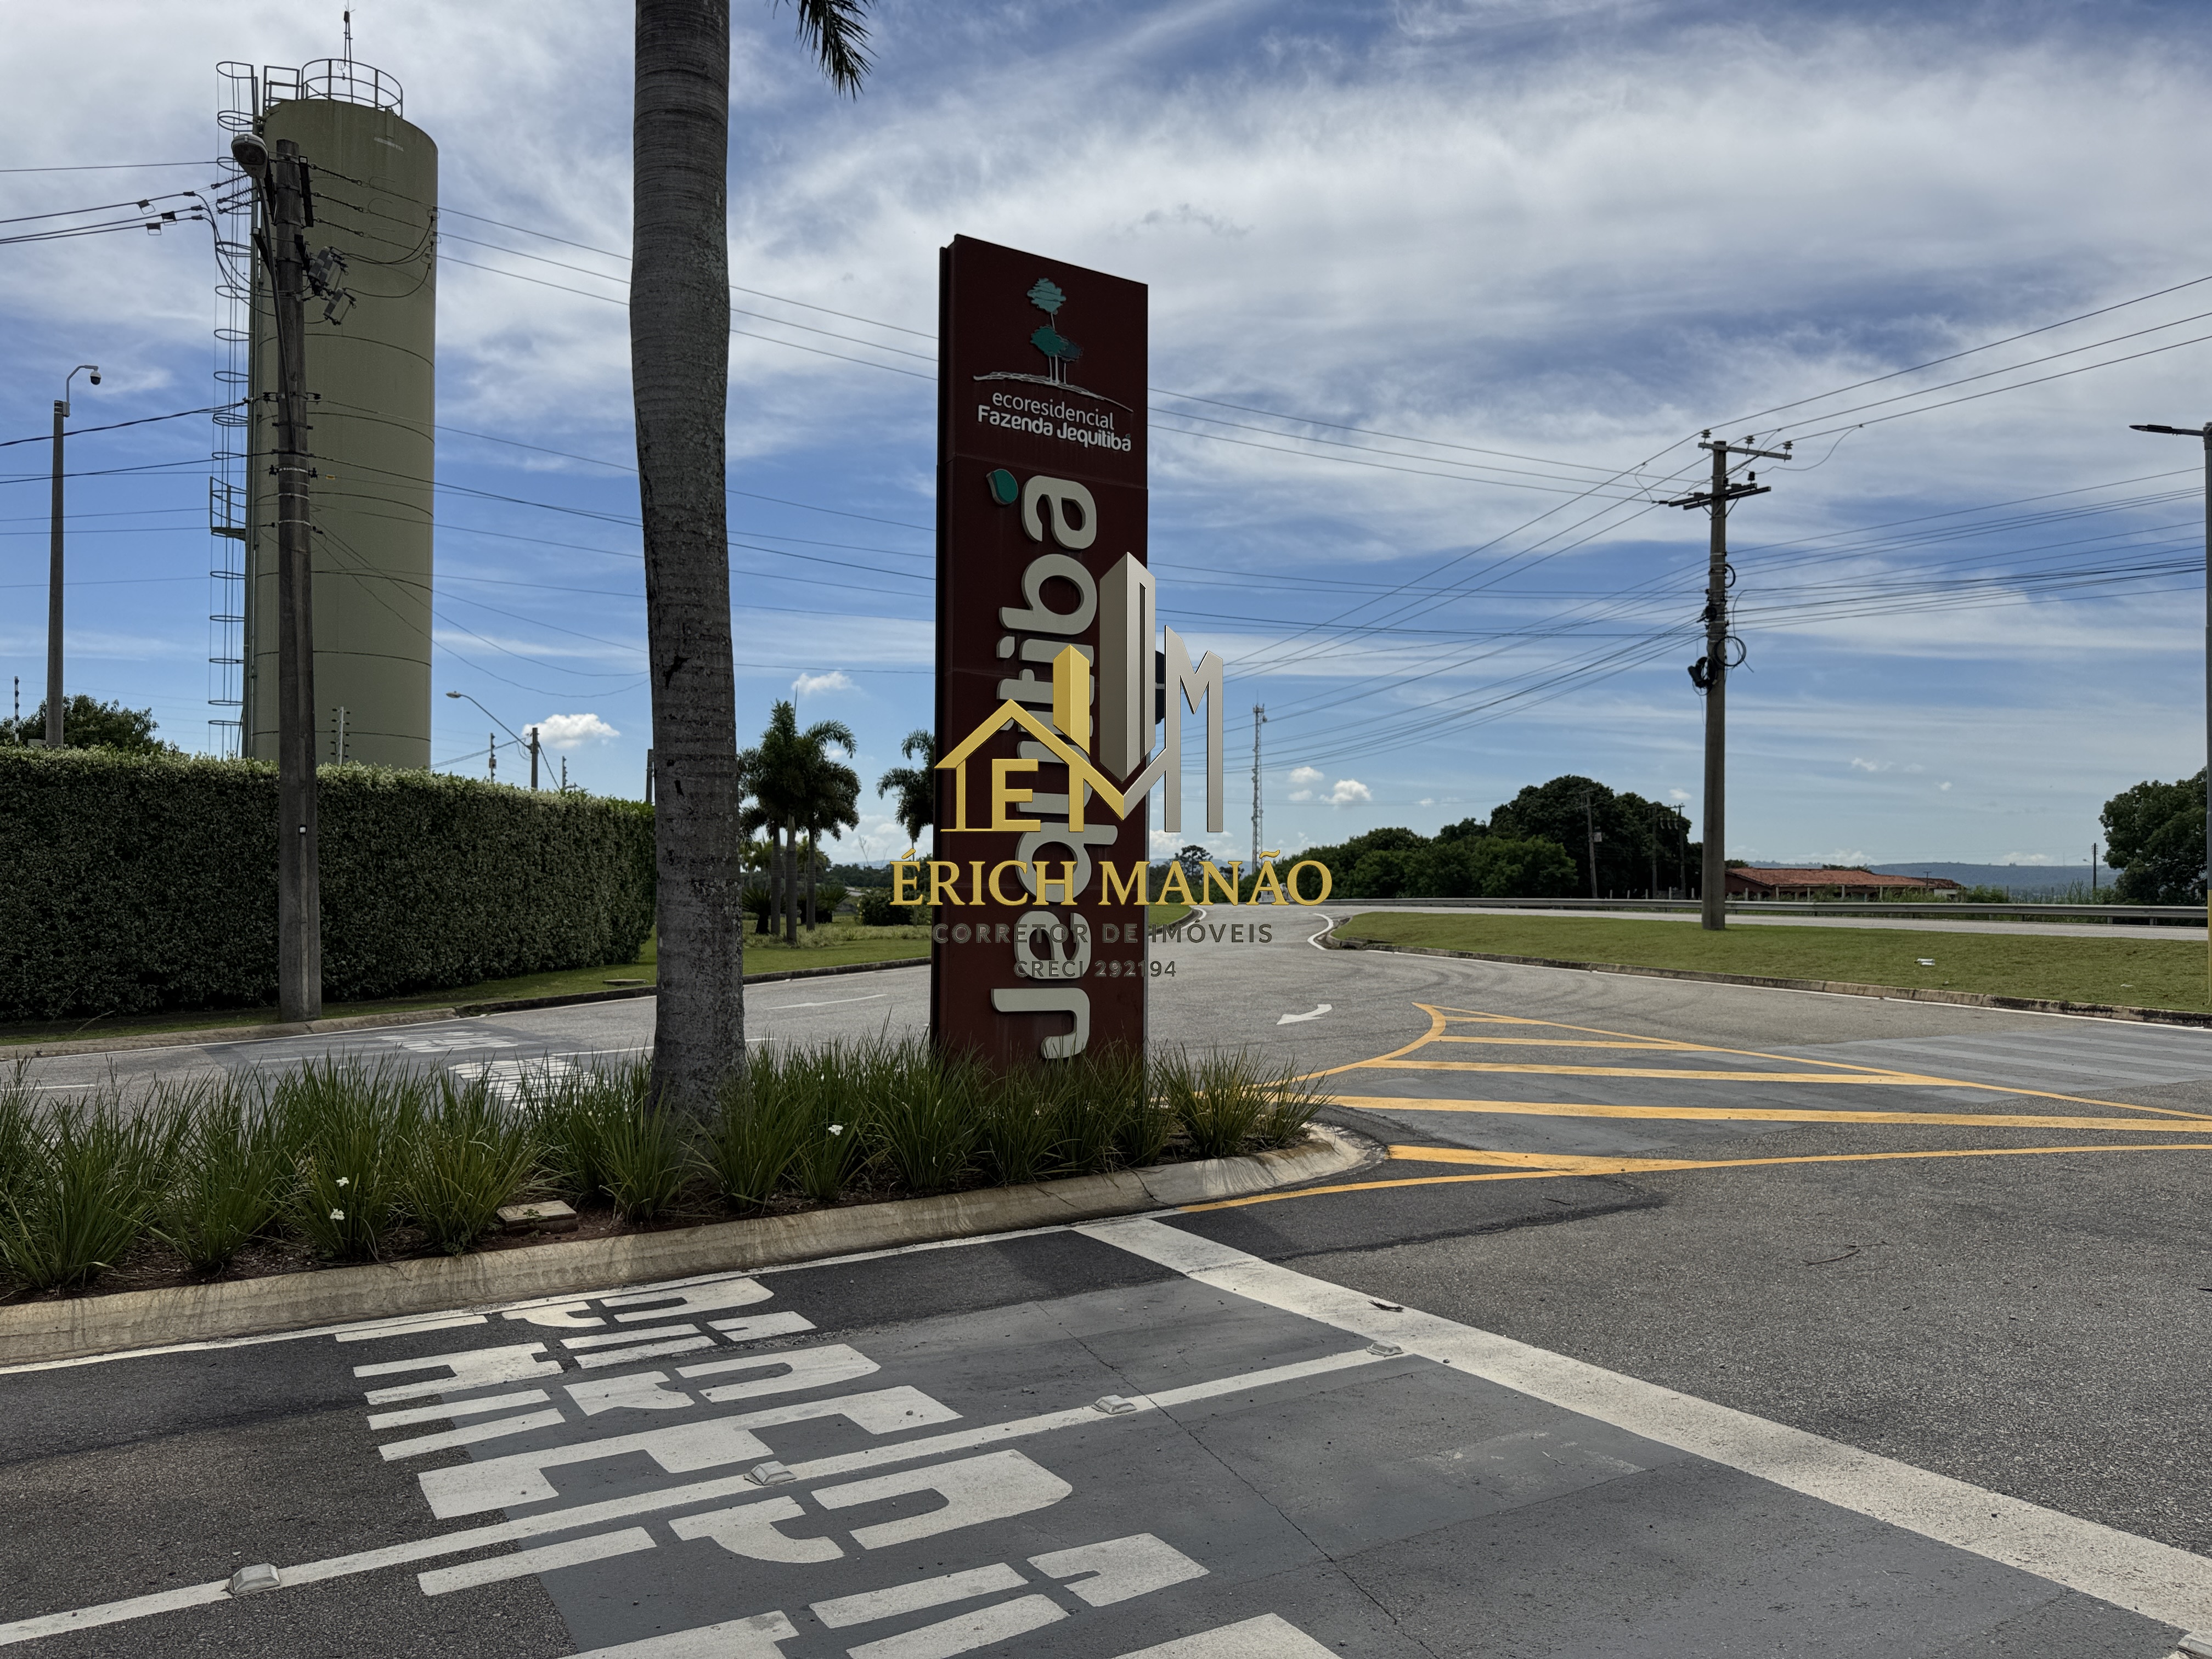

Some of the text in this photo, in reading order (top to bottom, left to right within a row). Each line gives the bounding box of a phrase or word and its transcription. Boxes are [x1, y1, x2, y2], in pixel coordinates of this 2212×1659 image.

[977, 404, 1131, 452] Fazenda Jequitibá
[992, 392, 1115, 430] ecoresidencial
[335, 1276, 964, 1520] PARE
